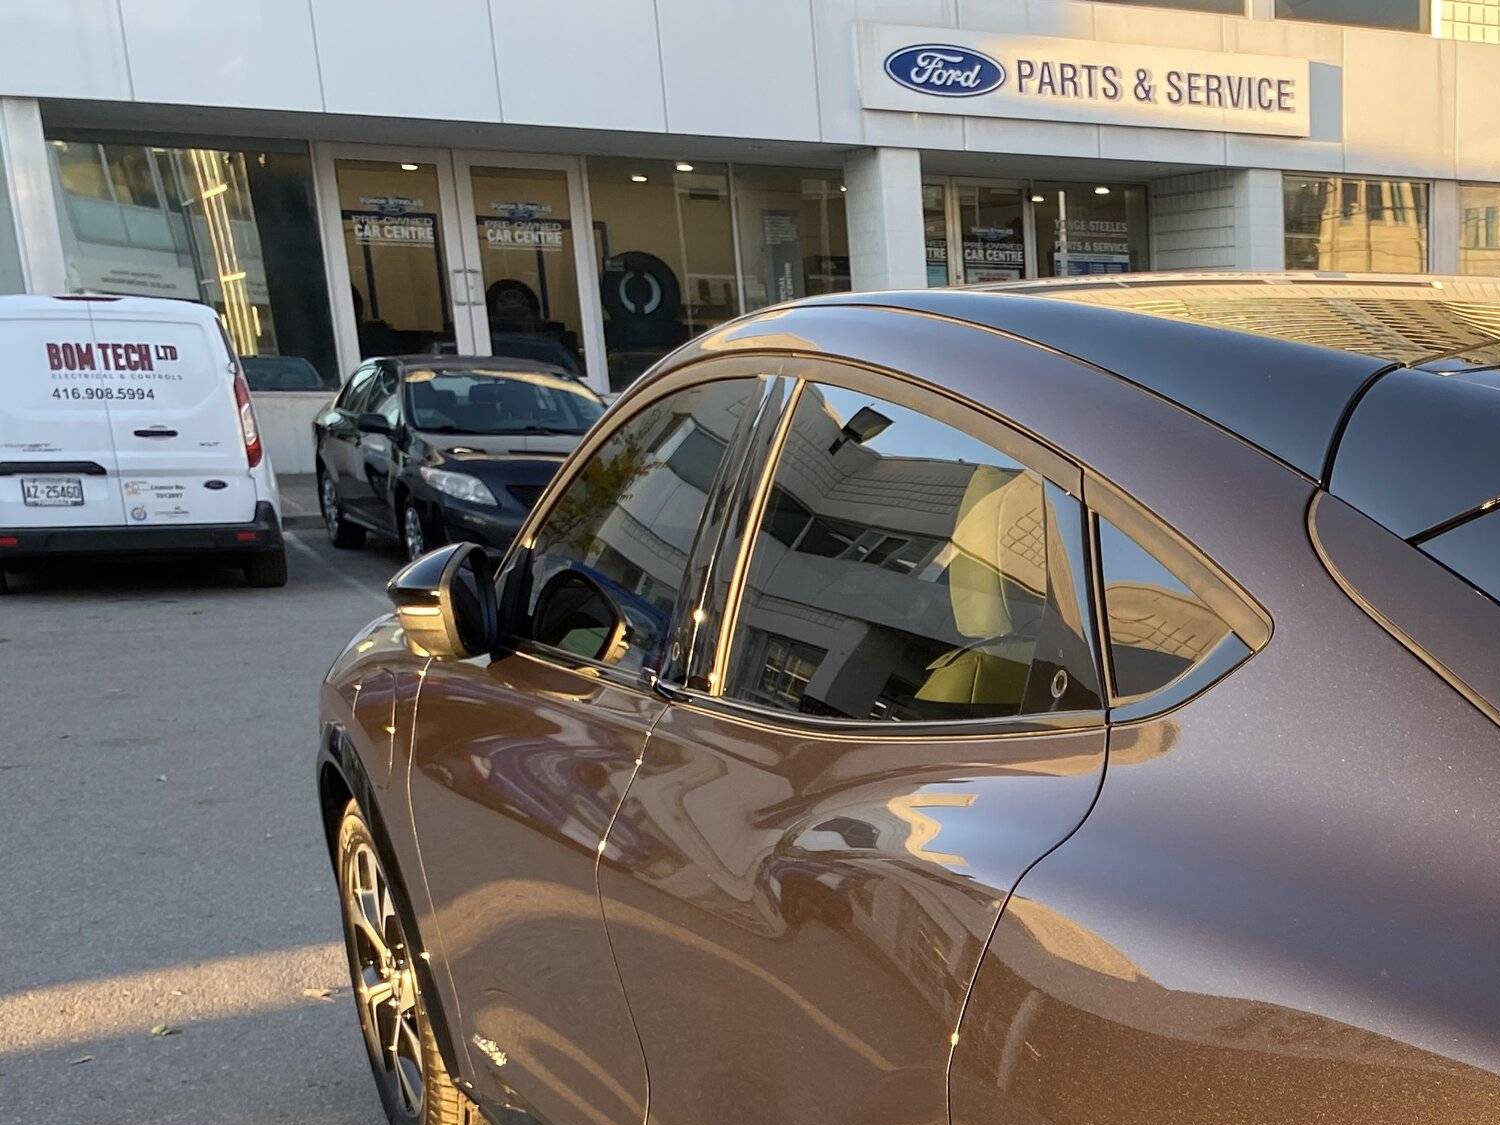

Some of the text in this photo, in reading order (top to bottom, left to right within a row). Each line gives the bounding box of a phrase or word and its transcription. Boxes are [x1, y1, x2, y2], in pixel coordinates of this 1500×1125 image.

[909, 51, 1294, 112] Ford PARTS & SERVICE
[354, 223, 435, 240] CAR CENTRE
[487, 228, 562, 244] CAR CENTRE
[1054, 240, 1082, 251] PRTS
[1093, 242, 1128, 253] SERVICE
[964, 250, 1024, 262] CAR CENTRE
[46, 342, 179, 372] BOM TECH LTD
[51, 372, 115, 381] ELECTRICAL
[130, 373, 184, 381] CONTROLS
[52, 387, 156, 400] 416.908.5994
